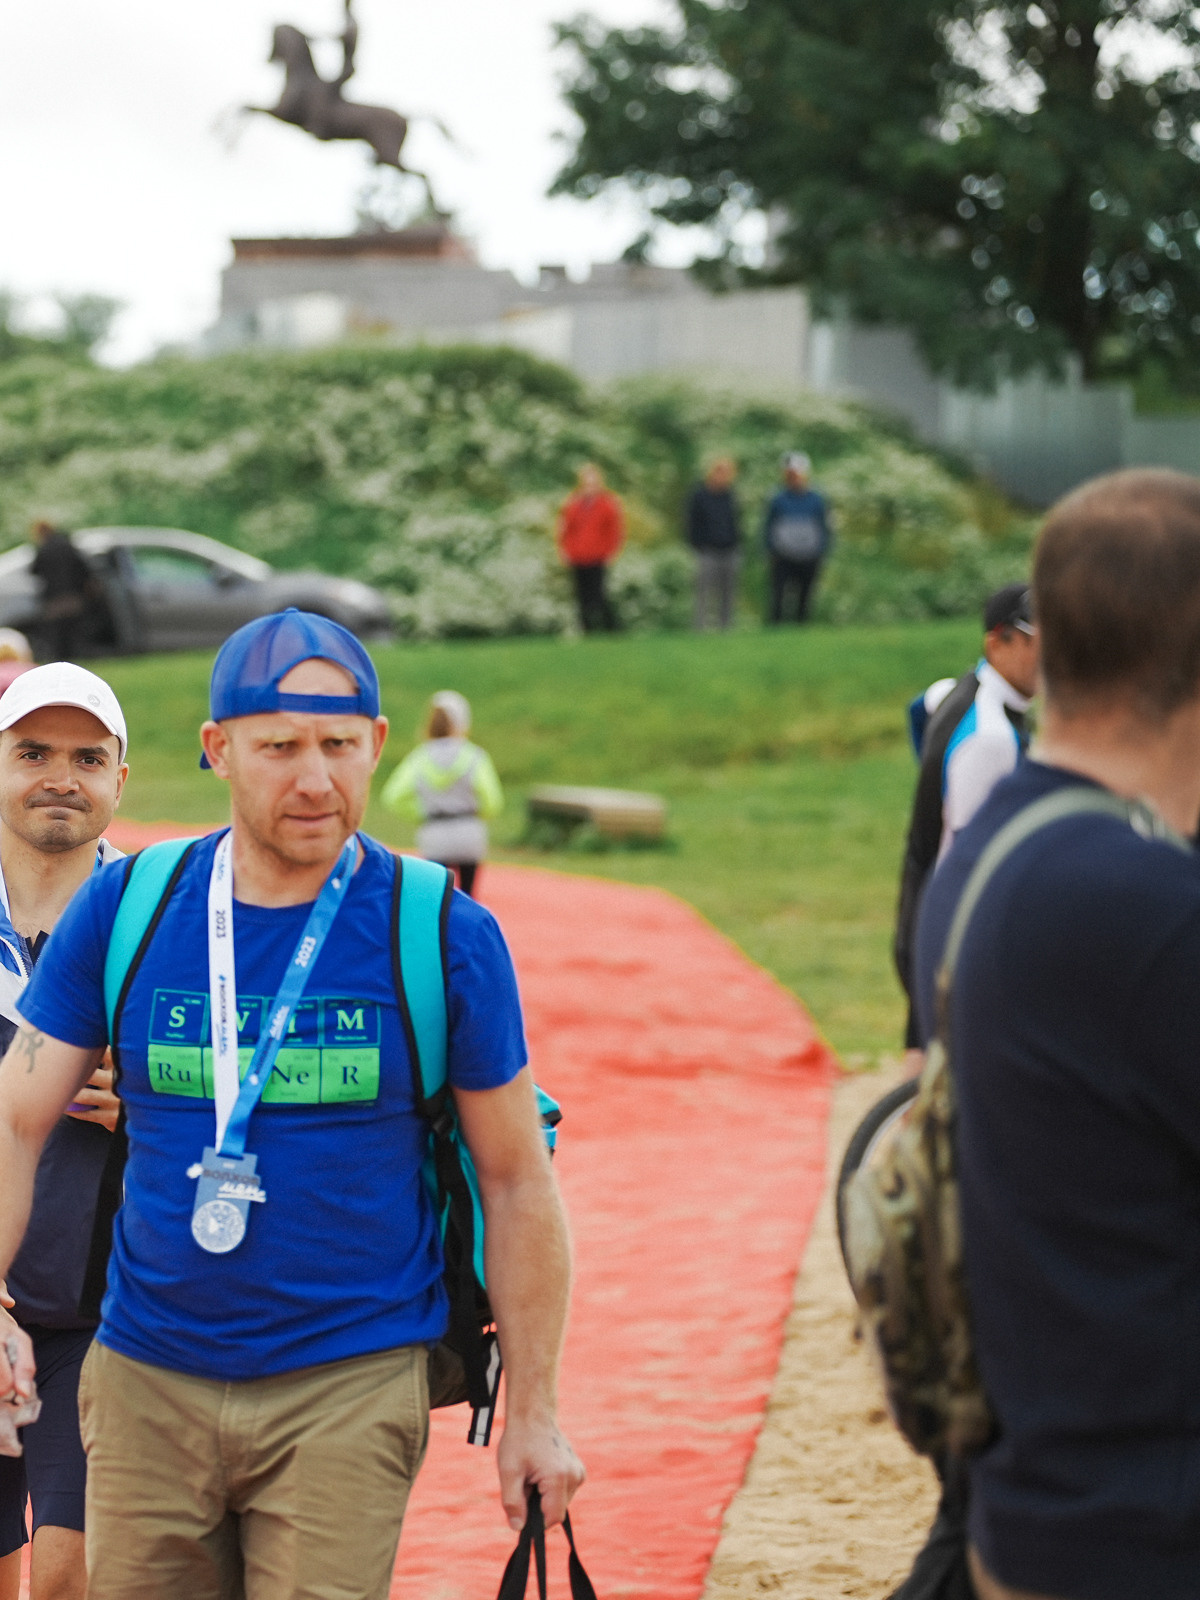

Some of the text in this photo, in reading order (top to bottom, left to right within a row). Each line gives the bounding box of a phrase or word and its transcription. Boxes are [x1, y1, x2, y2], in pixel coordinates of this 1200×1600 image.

[216, 909, 226, 939] 2023
[295, 936, 316, 968] 2023
[168, 1005, 186, 1028] S
[337, 1008, 364, 1030] M
[157, 1062, 359, 1085] Ru Ne R
